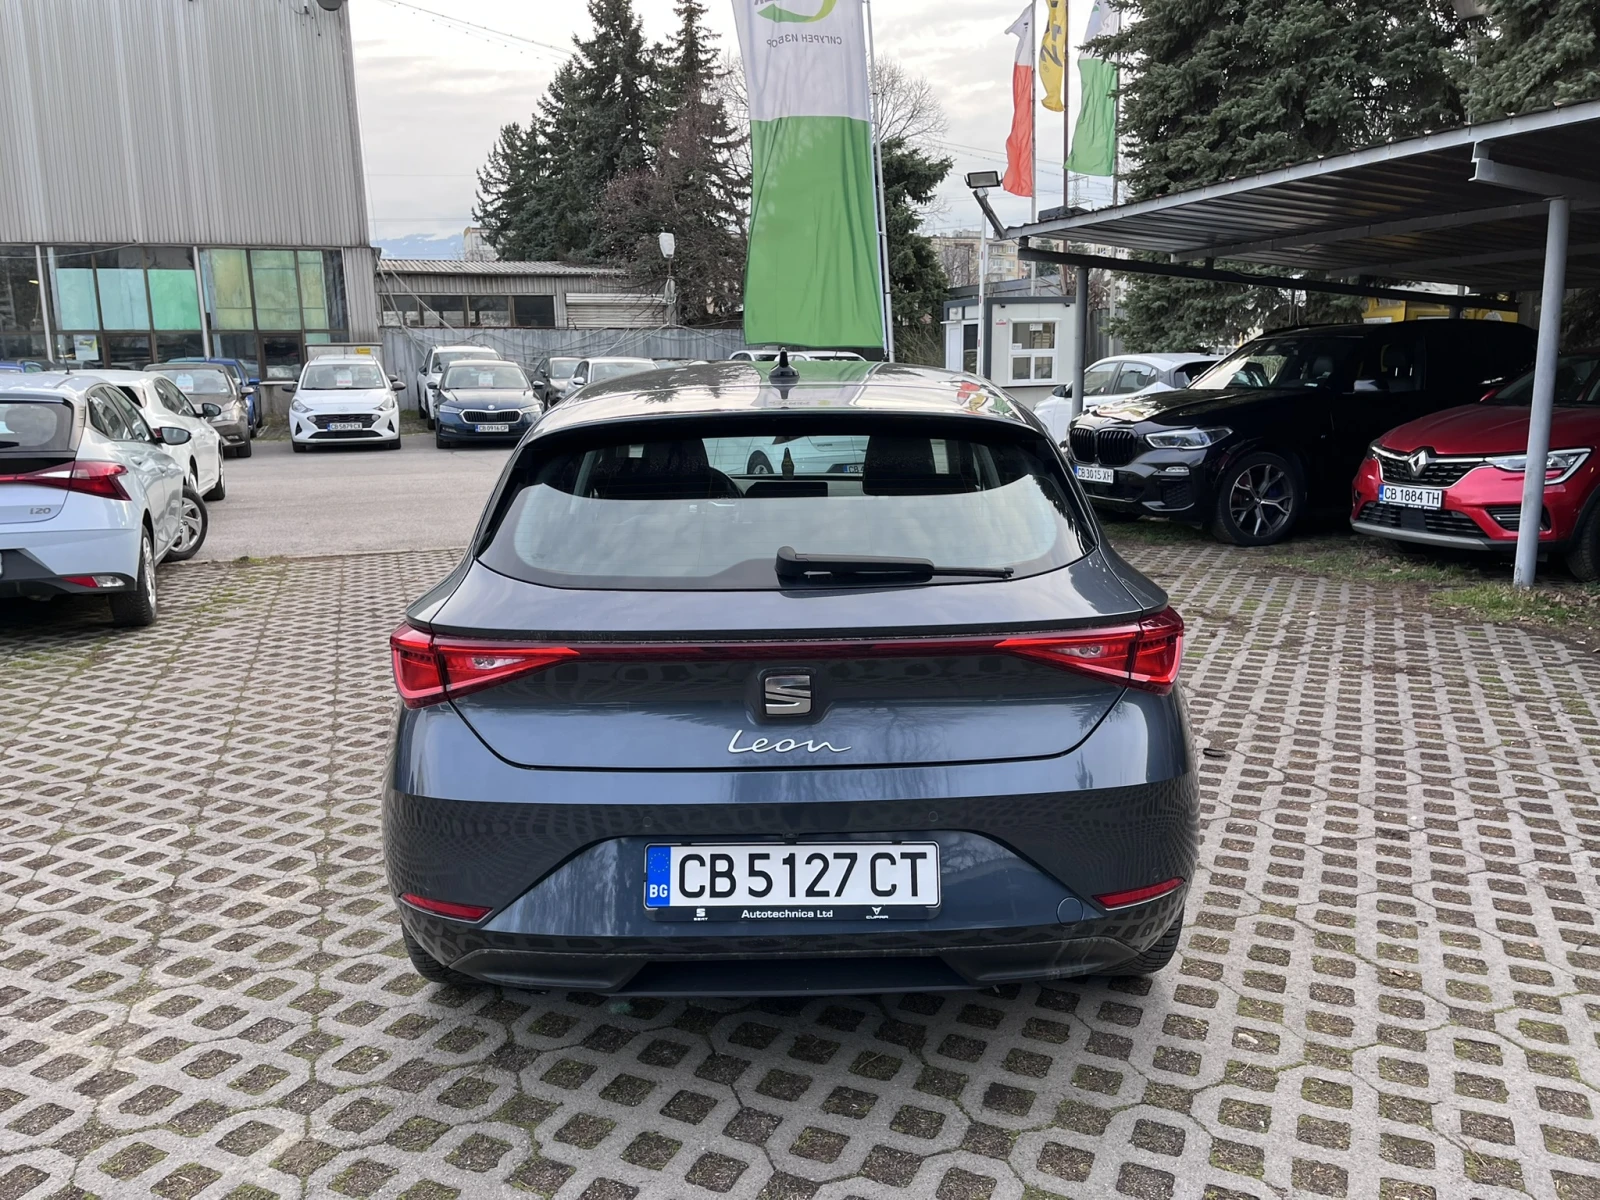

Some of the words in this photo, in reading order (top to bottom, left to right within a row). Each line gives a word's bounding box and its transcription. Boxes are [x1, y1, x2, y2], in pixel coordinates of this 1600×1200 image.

[1078, 467, 1086, 478] CB
[1086, 468, 1102, 480] 3015
[1102, 470, 1113, 481] XH
[1384, 487, 1397, 500] CB
[1400, 488, 1423, 503] 1884
[1425, 491, 1440, 505] TH
[728, 729, 851, 753] Leon
[678, 853, 737, 899] CB
[748, 852, 858, 898] 5127
[869, 852, 928, 898] CT
[649, 884, 668, 898] BG
[741, 909, 815, 919] Autotechnica
[816, 909, 834, 918] Ltd
